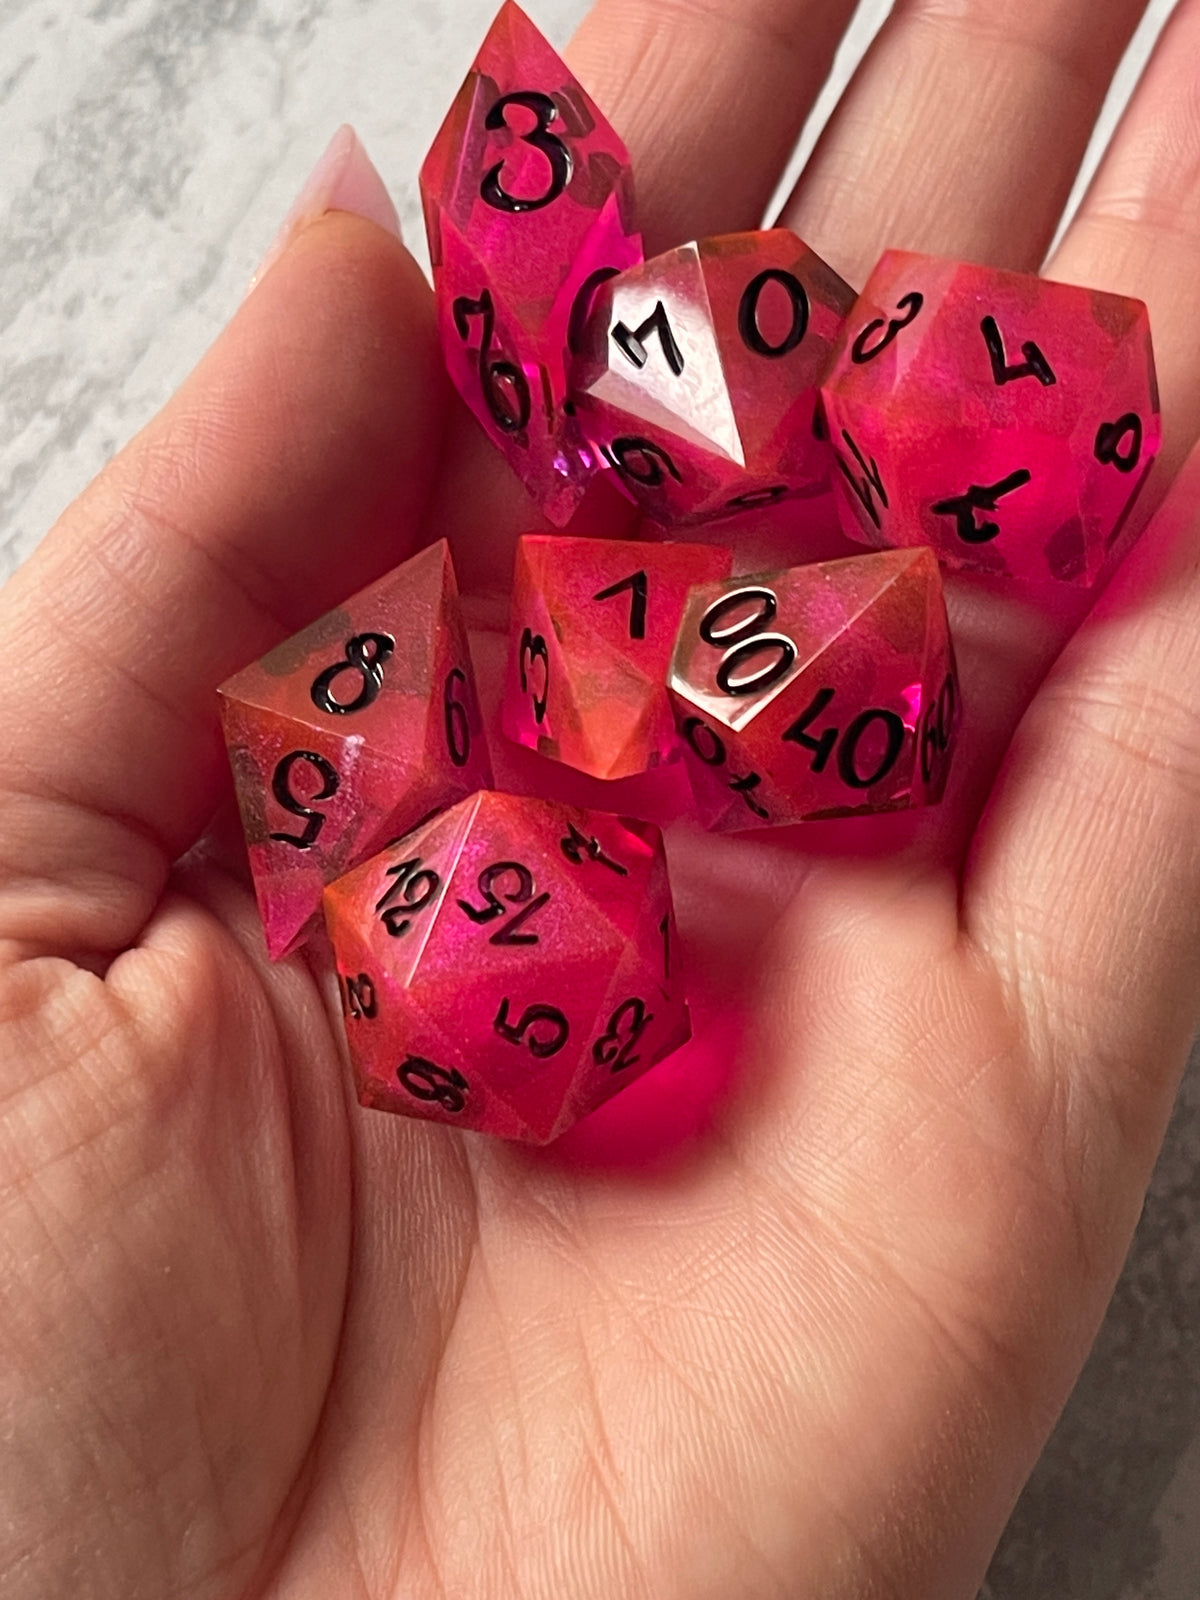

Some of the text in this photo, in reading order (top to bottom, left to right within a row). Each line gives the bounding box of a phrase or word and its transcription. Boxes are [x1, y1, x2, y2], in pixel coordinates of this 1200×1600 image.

[480, 90, 574, 214] 3
[737, 268, 810, 358] 0
[852, 292, 924, 364] 3
[980, 315, 1056, 386] 4
[1093, 412, 1142, 473] 8
[592, 570, 648, 640] 1
[699, 586, 799, 695] 00
[310, 632, 396, 715] 8
[519, 627, 549, 726] 3
[444, 668, 471, 768] 6
[781, 688, 905, 789] 40
[269, 749, 341, 850] 5
[374, 857, 440, 937] 12
[456, 861, 551, 945] 15
[493, 997, 570, 1060] 5
[592, 997, 654, 1074] 13
